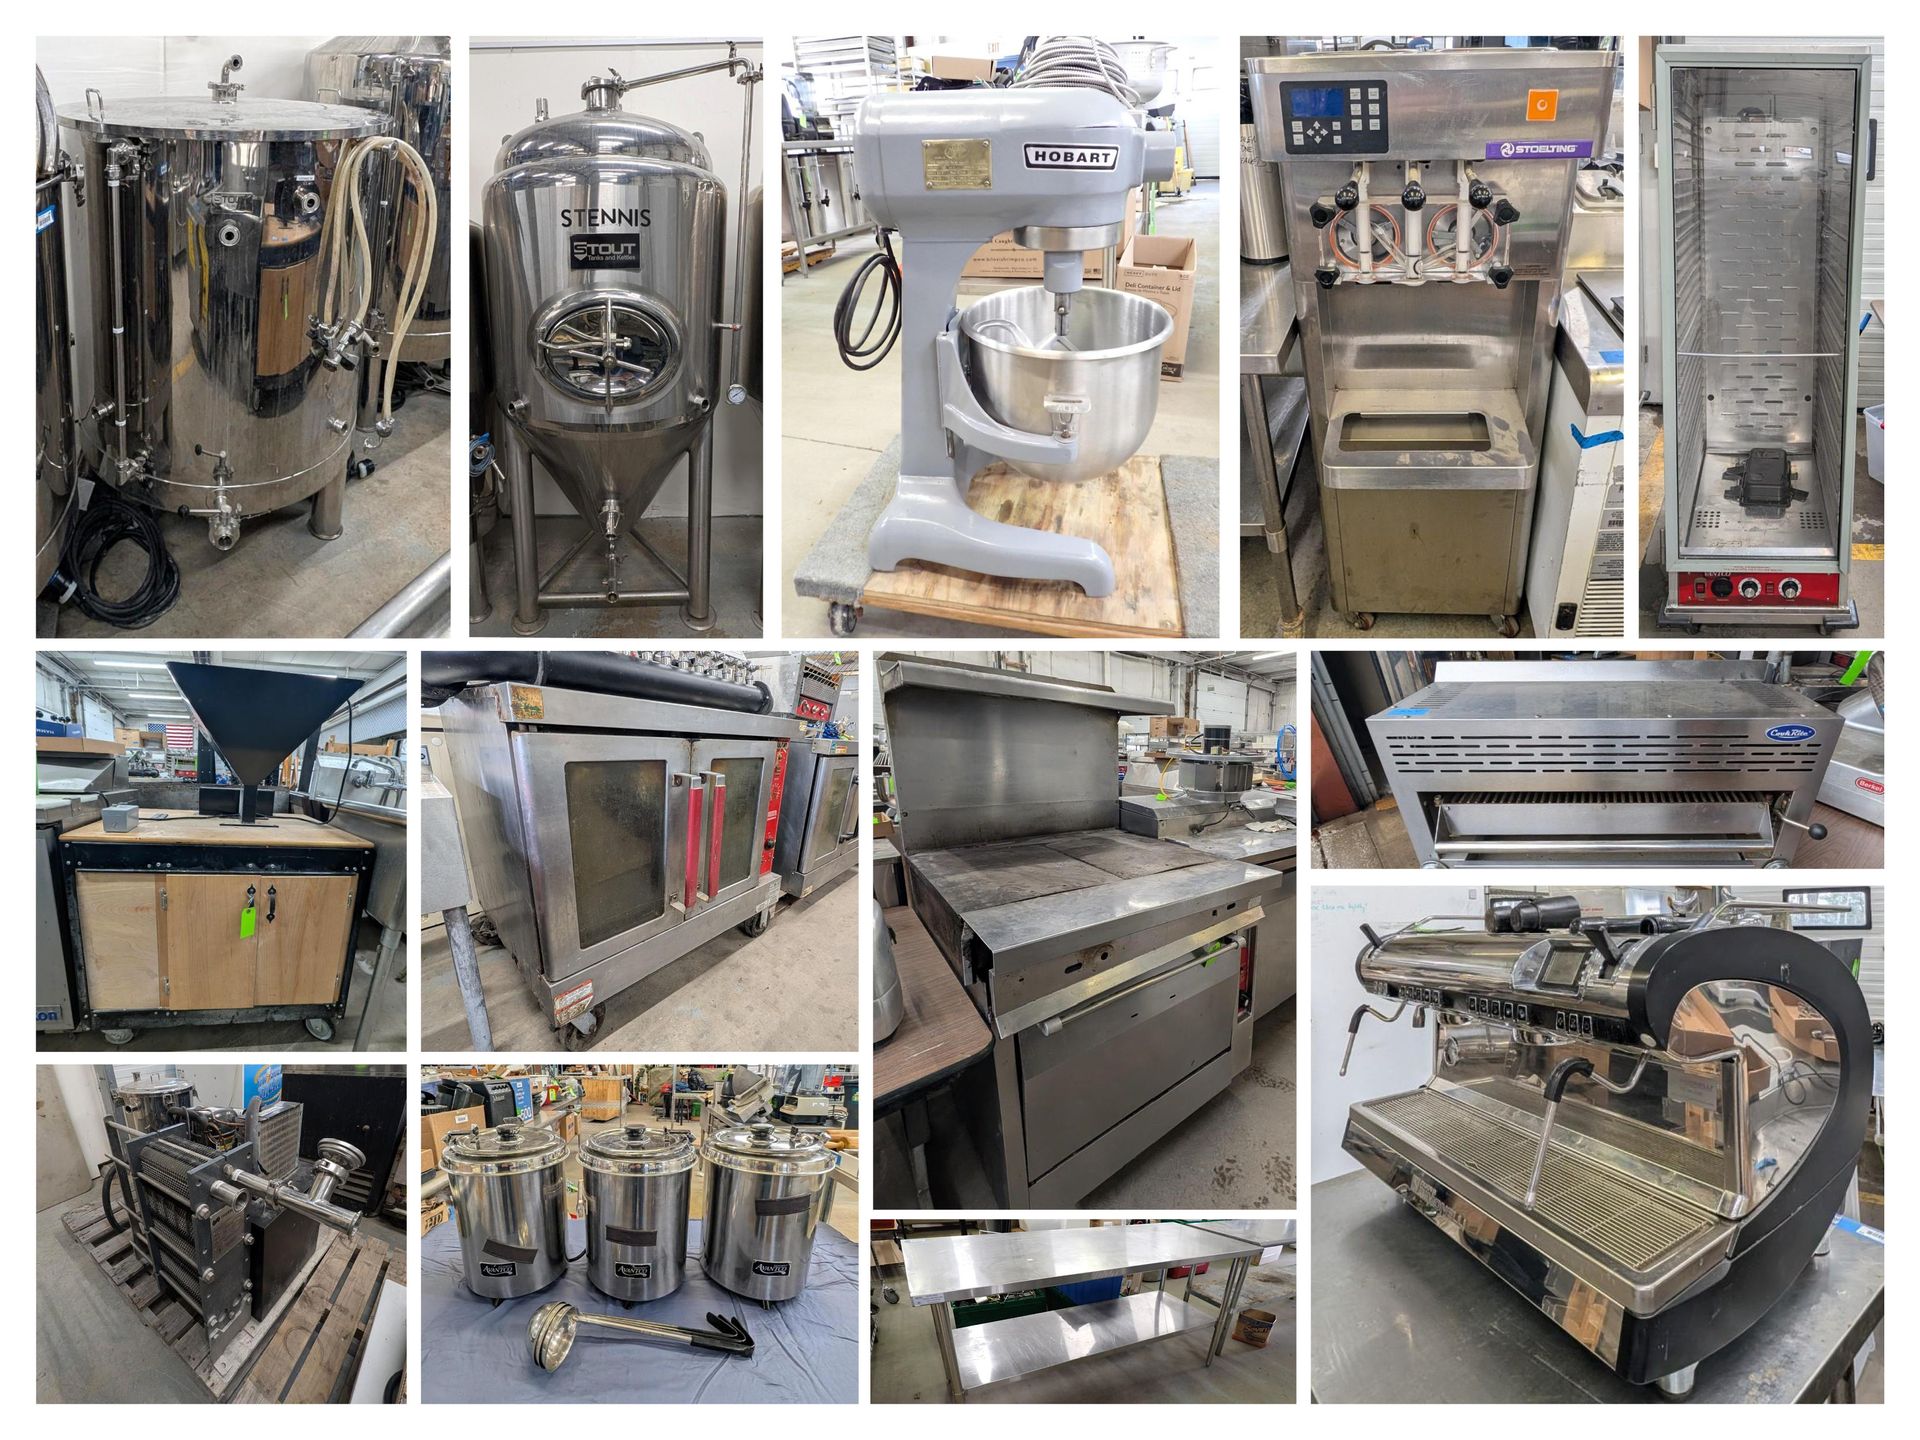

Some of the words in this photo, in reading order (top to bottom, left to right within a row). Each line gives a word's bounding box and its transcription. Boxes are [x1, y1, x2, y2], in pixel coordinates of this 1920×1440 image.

[1515, 144, 1576, 154] STOELTING
[1034, 150, 1111, 163] HOBART
[561, 208, 651, 227] STENNIS
[573, 242, 636, 257] STOUT
[1137, 283, 1165, 291] Container
[1859, 780, 1883, 792] Berkel
